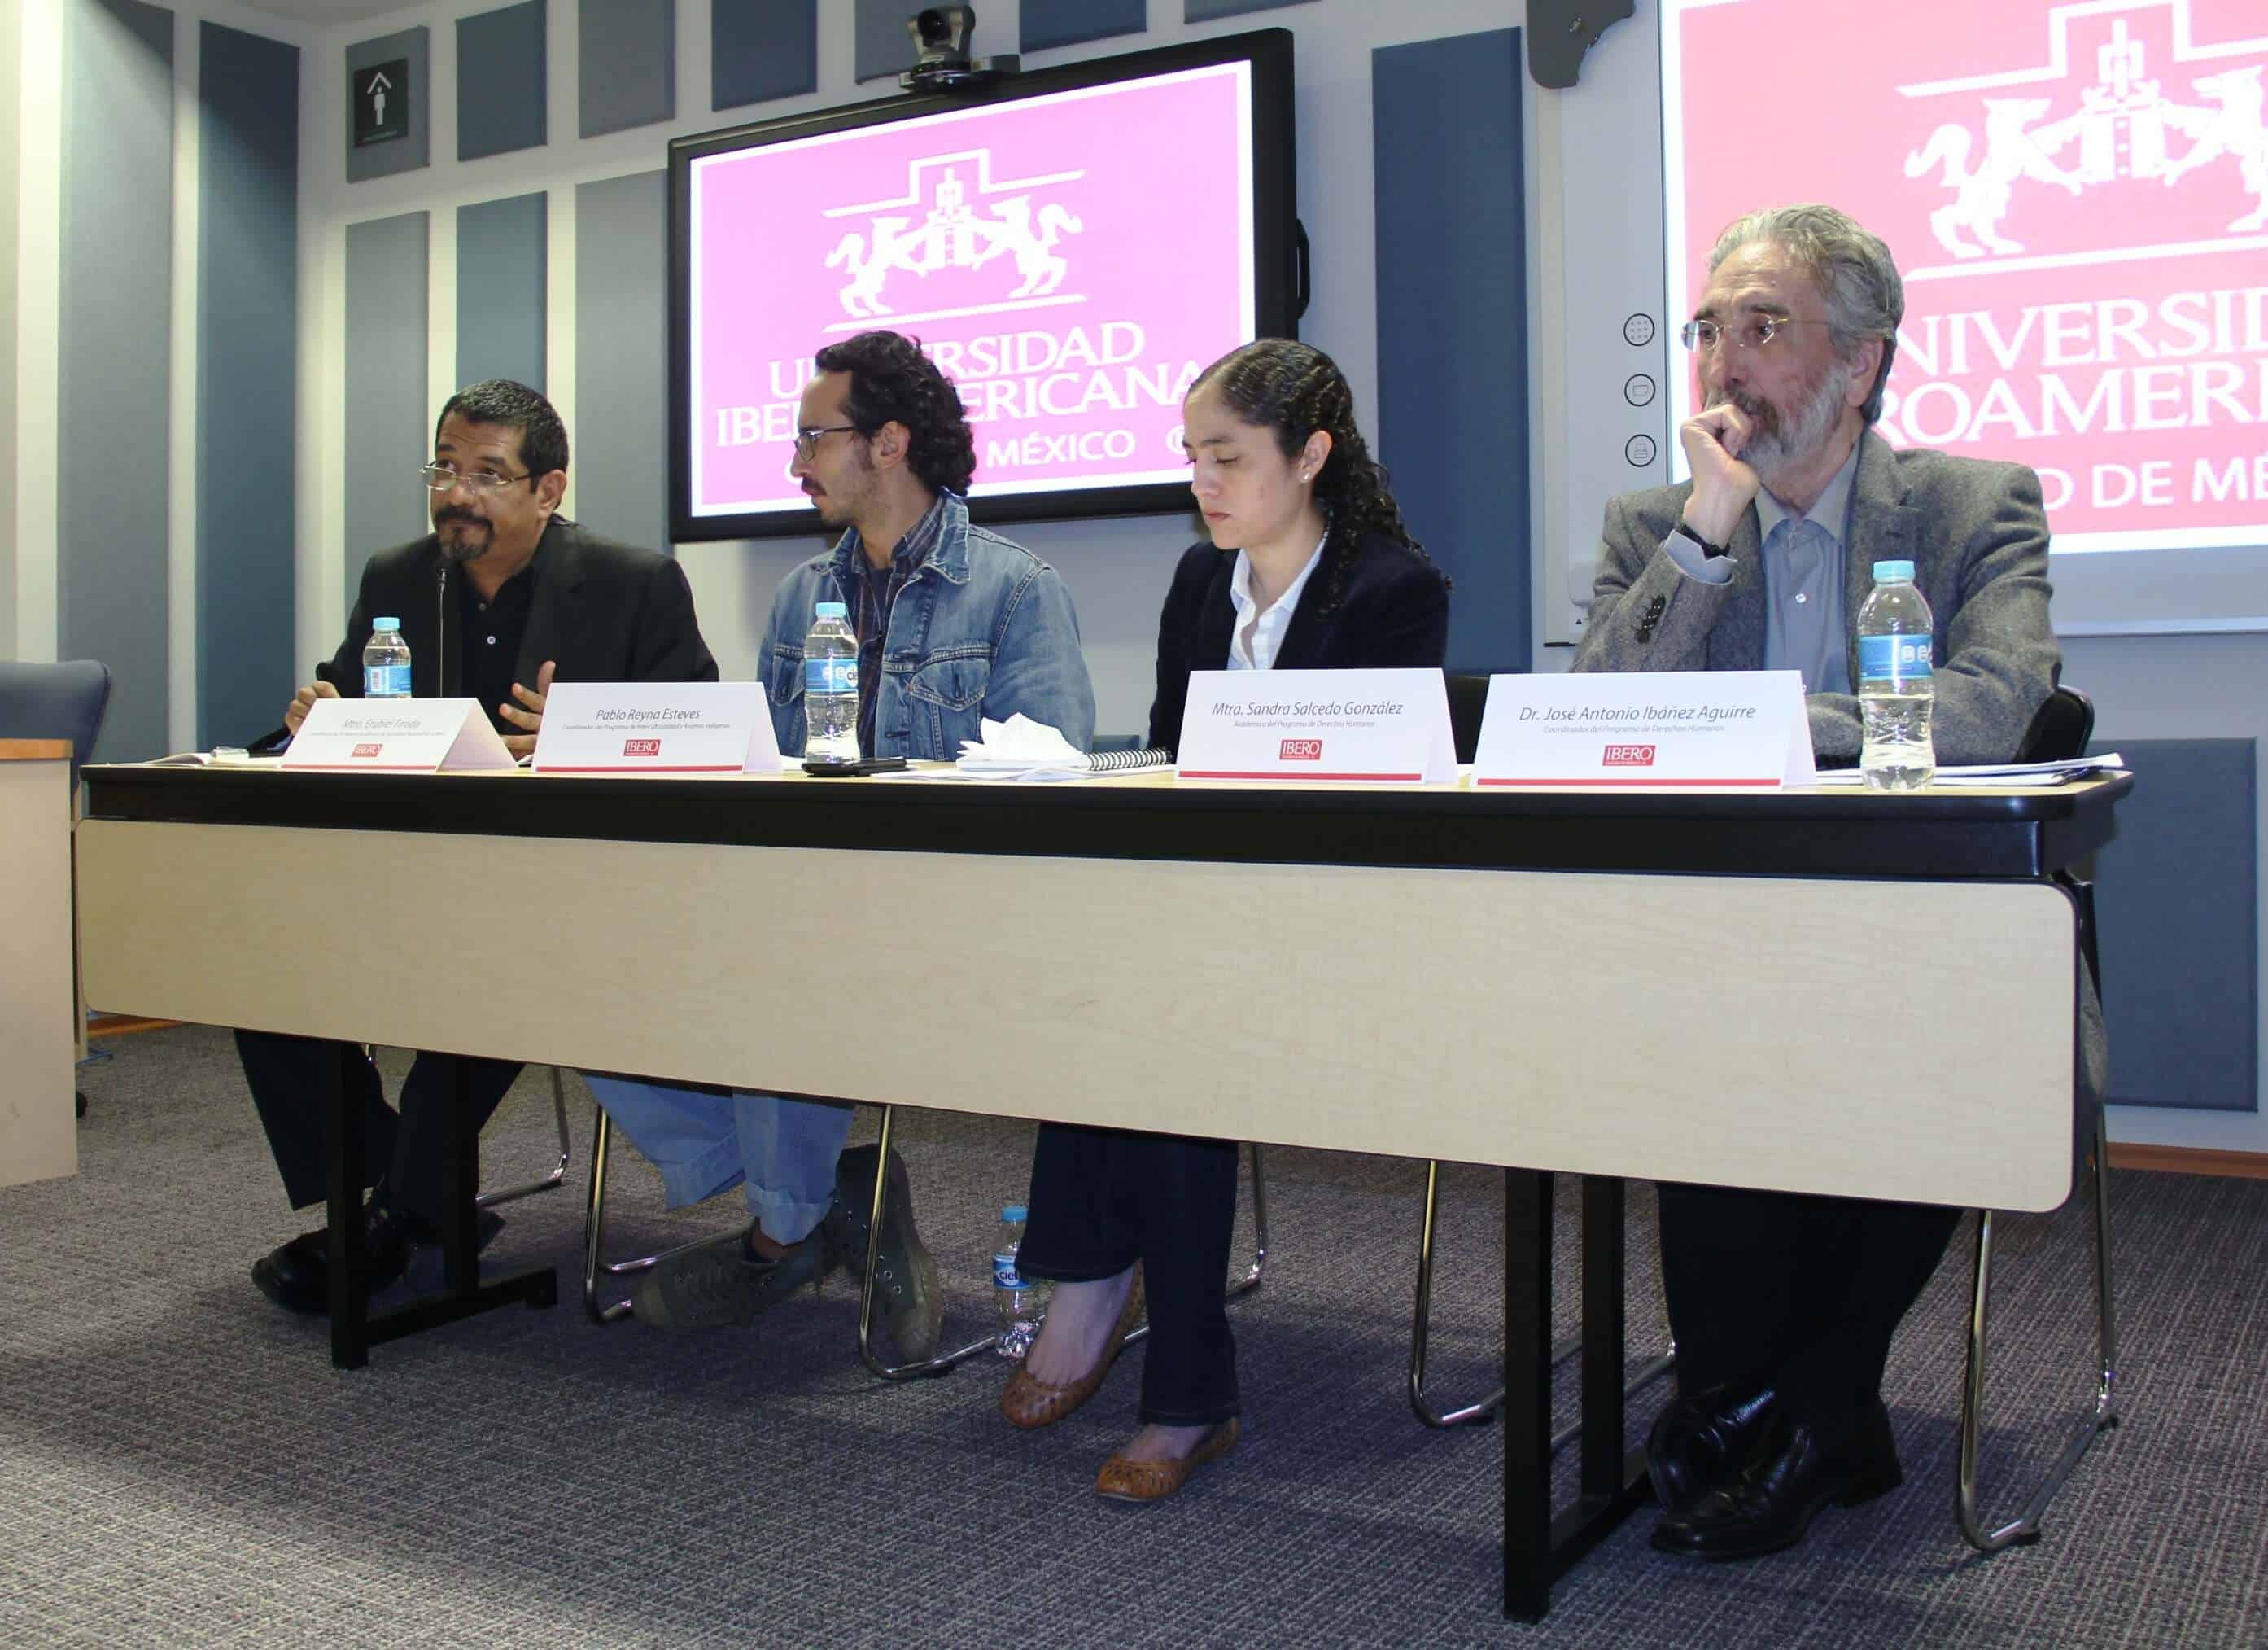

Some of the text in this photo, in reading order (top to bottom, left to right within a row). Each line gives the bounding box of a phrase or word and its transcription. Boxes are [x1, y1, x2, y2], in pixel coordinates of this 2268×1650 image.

[986, 430, 1135, 469] MÉXICO
[2091, 460, 2174, 509] DE
[595, 707, 701, 723] Pablo Reyna Esteves
[1211, 701, 1403, 716] Mtra. Sandra Salcedo González
[1519, 705, 1756, 723] Dr. José Antonio Ibáñez Aguirre
[625, 741, 659, 752] IBERO
[1282, 742, 1320, 755] IBERO
[1606, 746, 1652, 761] IBERO
